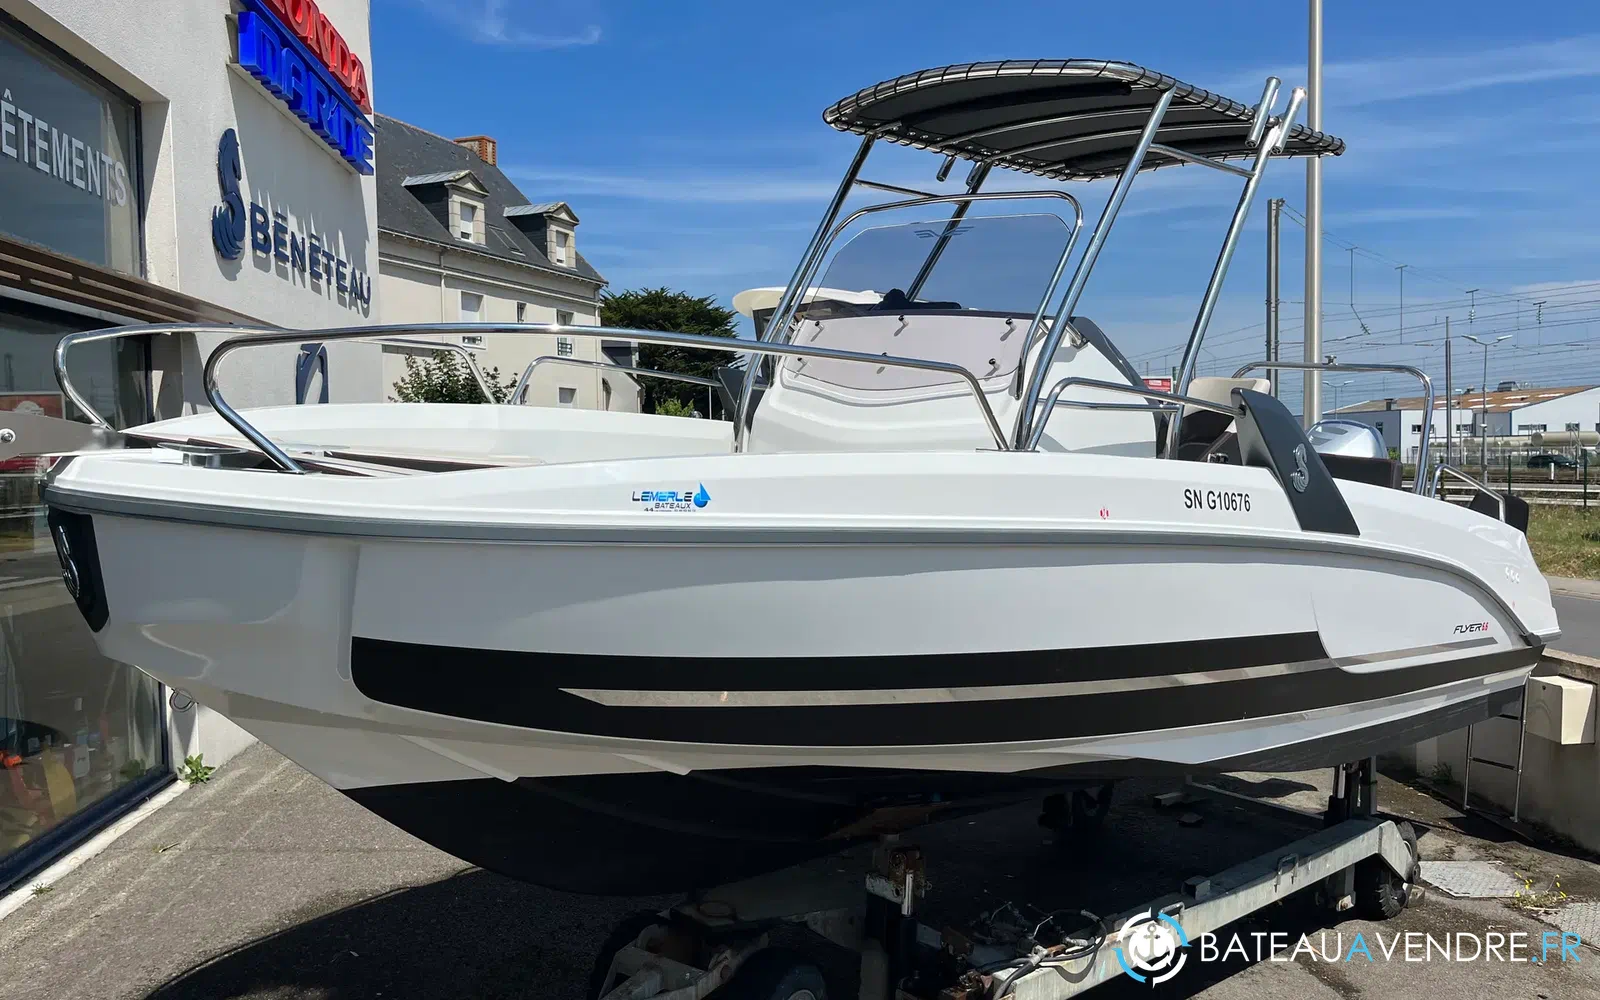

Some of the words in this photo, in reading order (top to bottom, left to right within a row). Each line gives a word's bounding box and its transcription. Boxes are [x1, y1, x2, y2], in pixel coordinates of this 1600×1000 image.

[258, 0, 373, 115] ONDA
[631, 490, 693, 502] LEMERLE
[1184, 488, 1203, 510] SN
[1206, 490, 1251, 512] G10676
